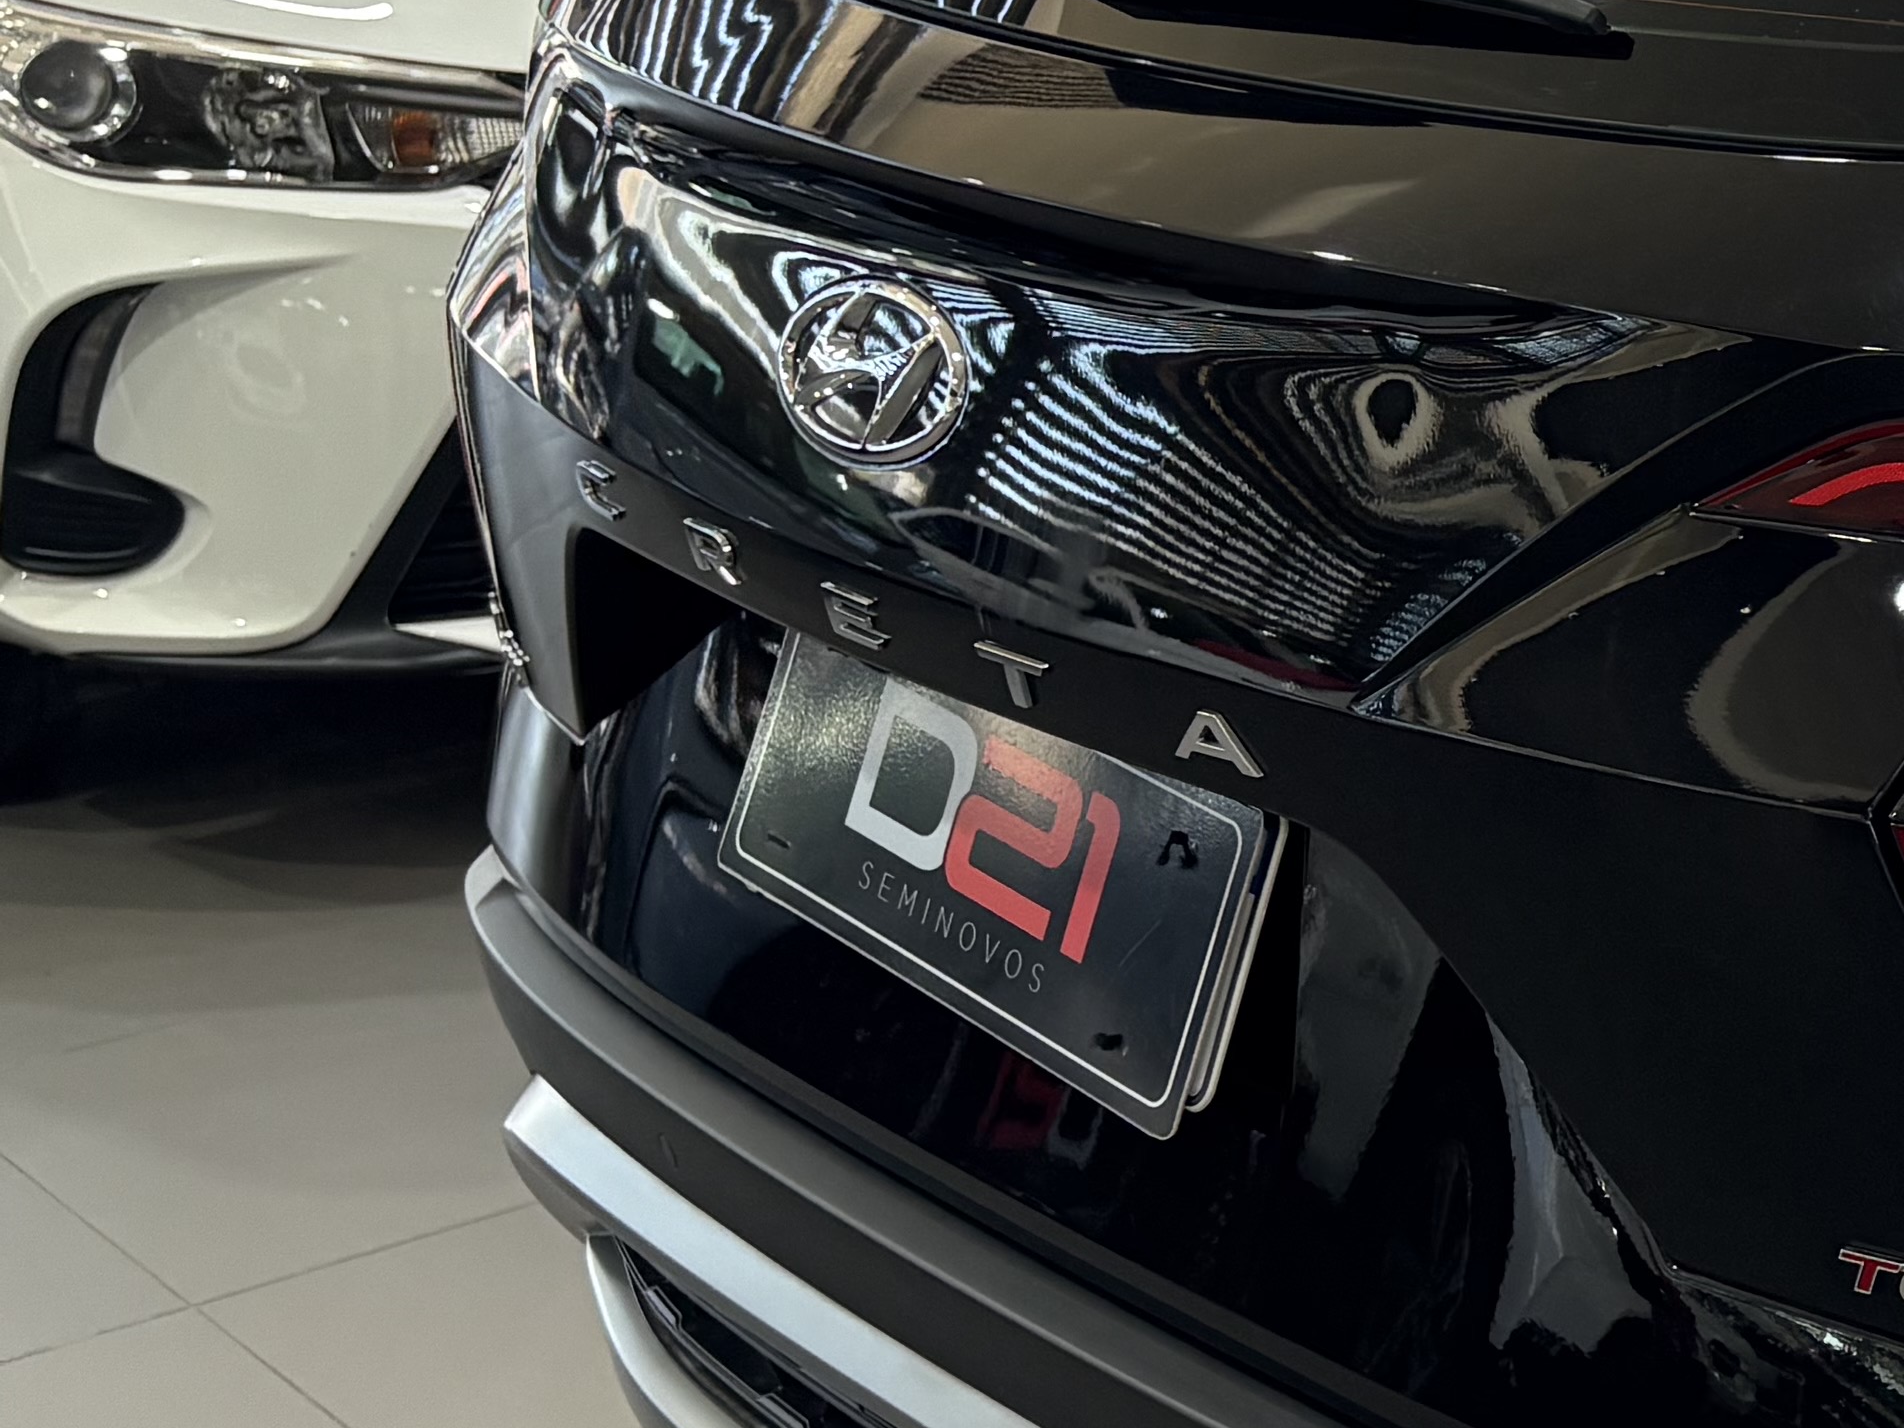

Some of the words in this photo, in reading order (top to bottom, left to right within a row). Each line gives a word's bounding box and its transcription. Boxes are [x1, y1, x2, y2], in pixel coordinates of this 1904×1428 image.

[574, 459, 1265, 780] CRETA
[843, 678, 1122, 965] D21
[856, 861, 1048, 995] SEMINOVOS
